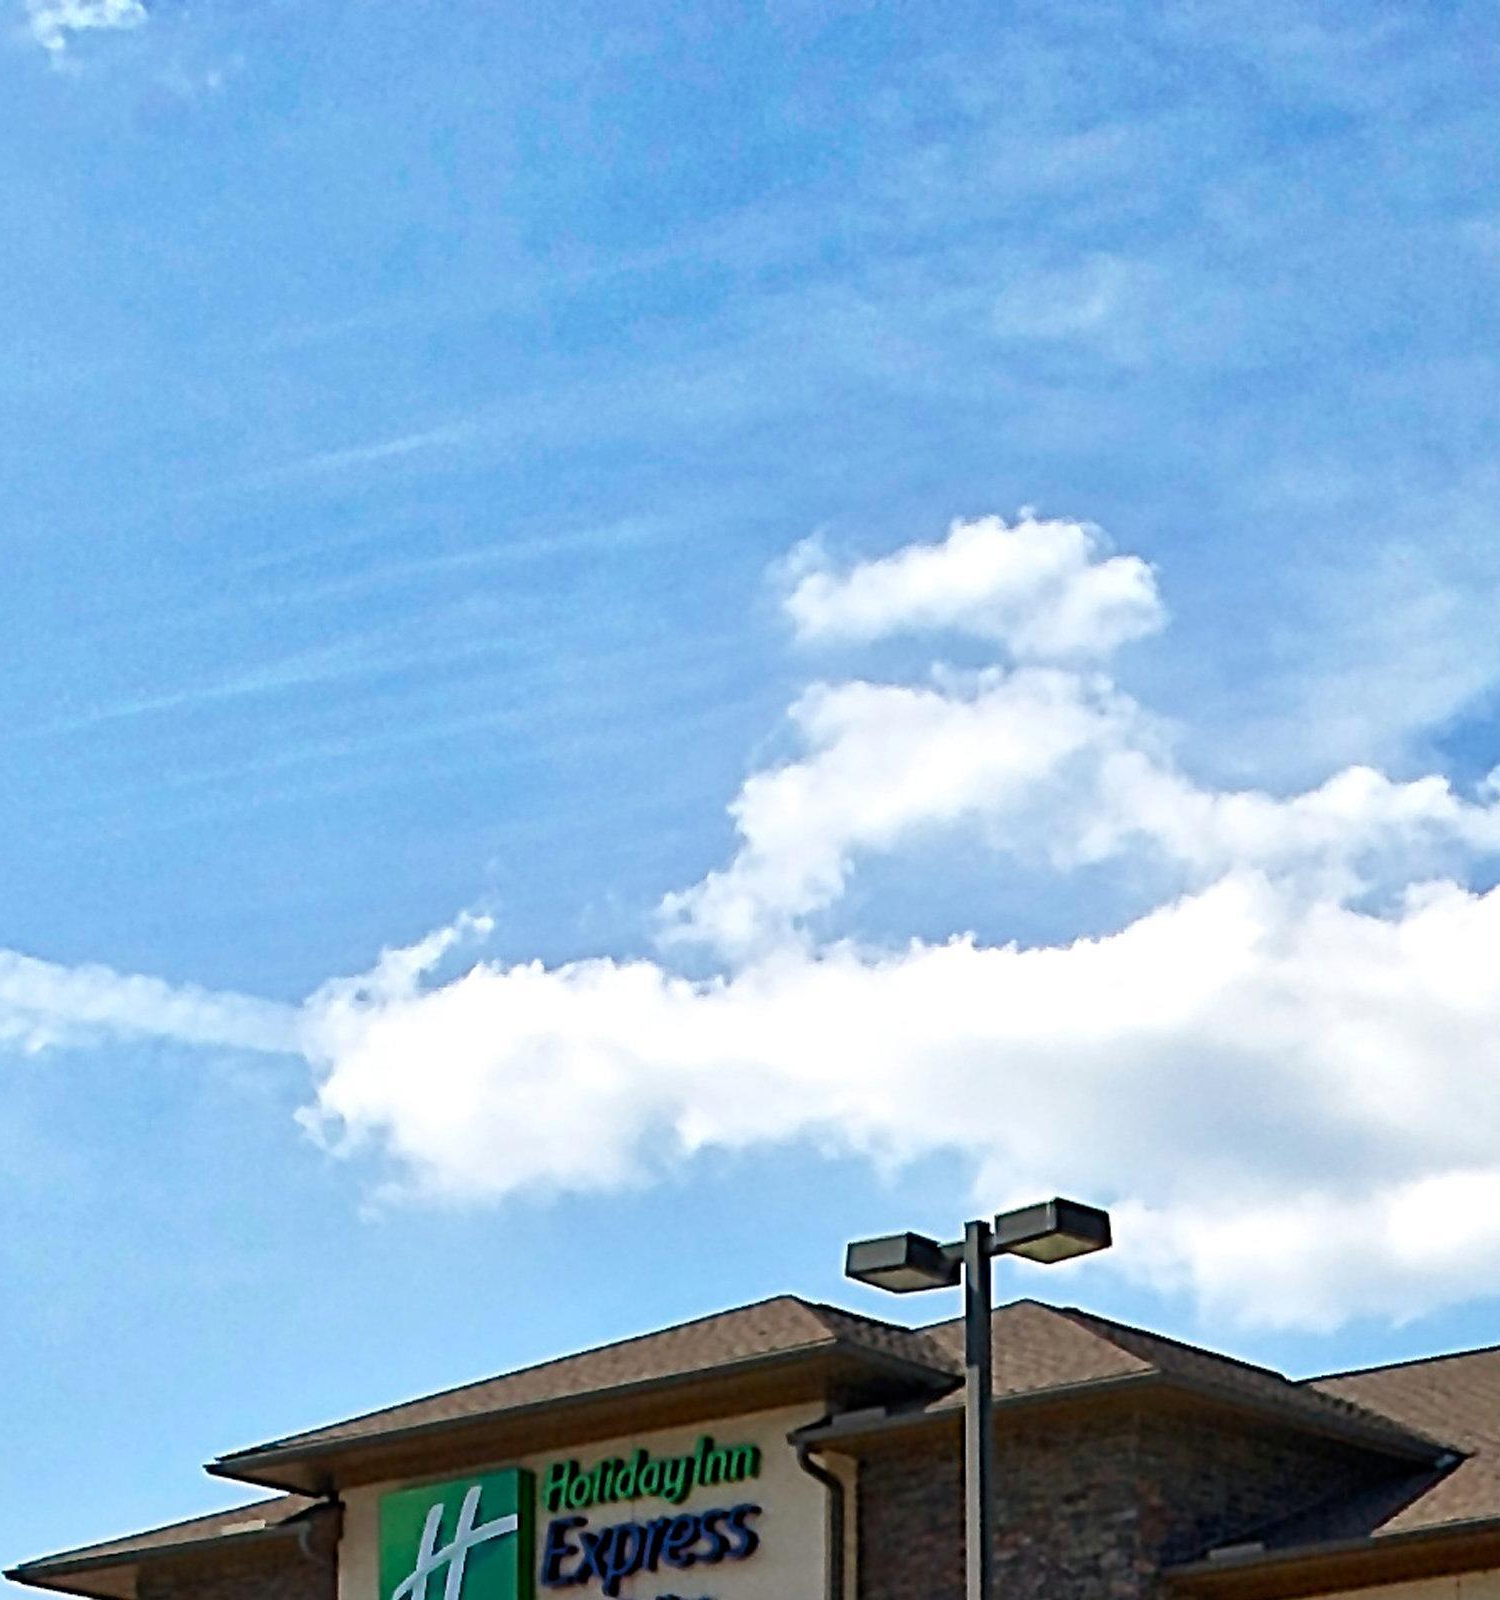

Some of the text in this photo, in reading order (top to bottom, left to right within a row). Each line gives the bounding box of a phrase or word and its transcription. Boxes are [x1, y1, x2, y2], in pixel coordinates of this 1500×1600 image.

[542, 1434, 762, 1512] Holiday Inn
[541, 1502, 763, 1598] Express
